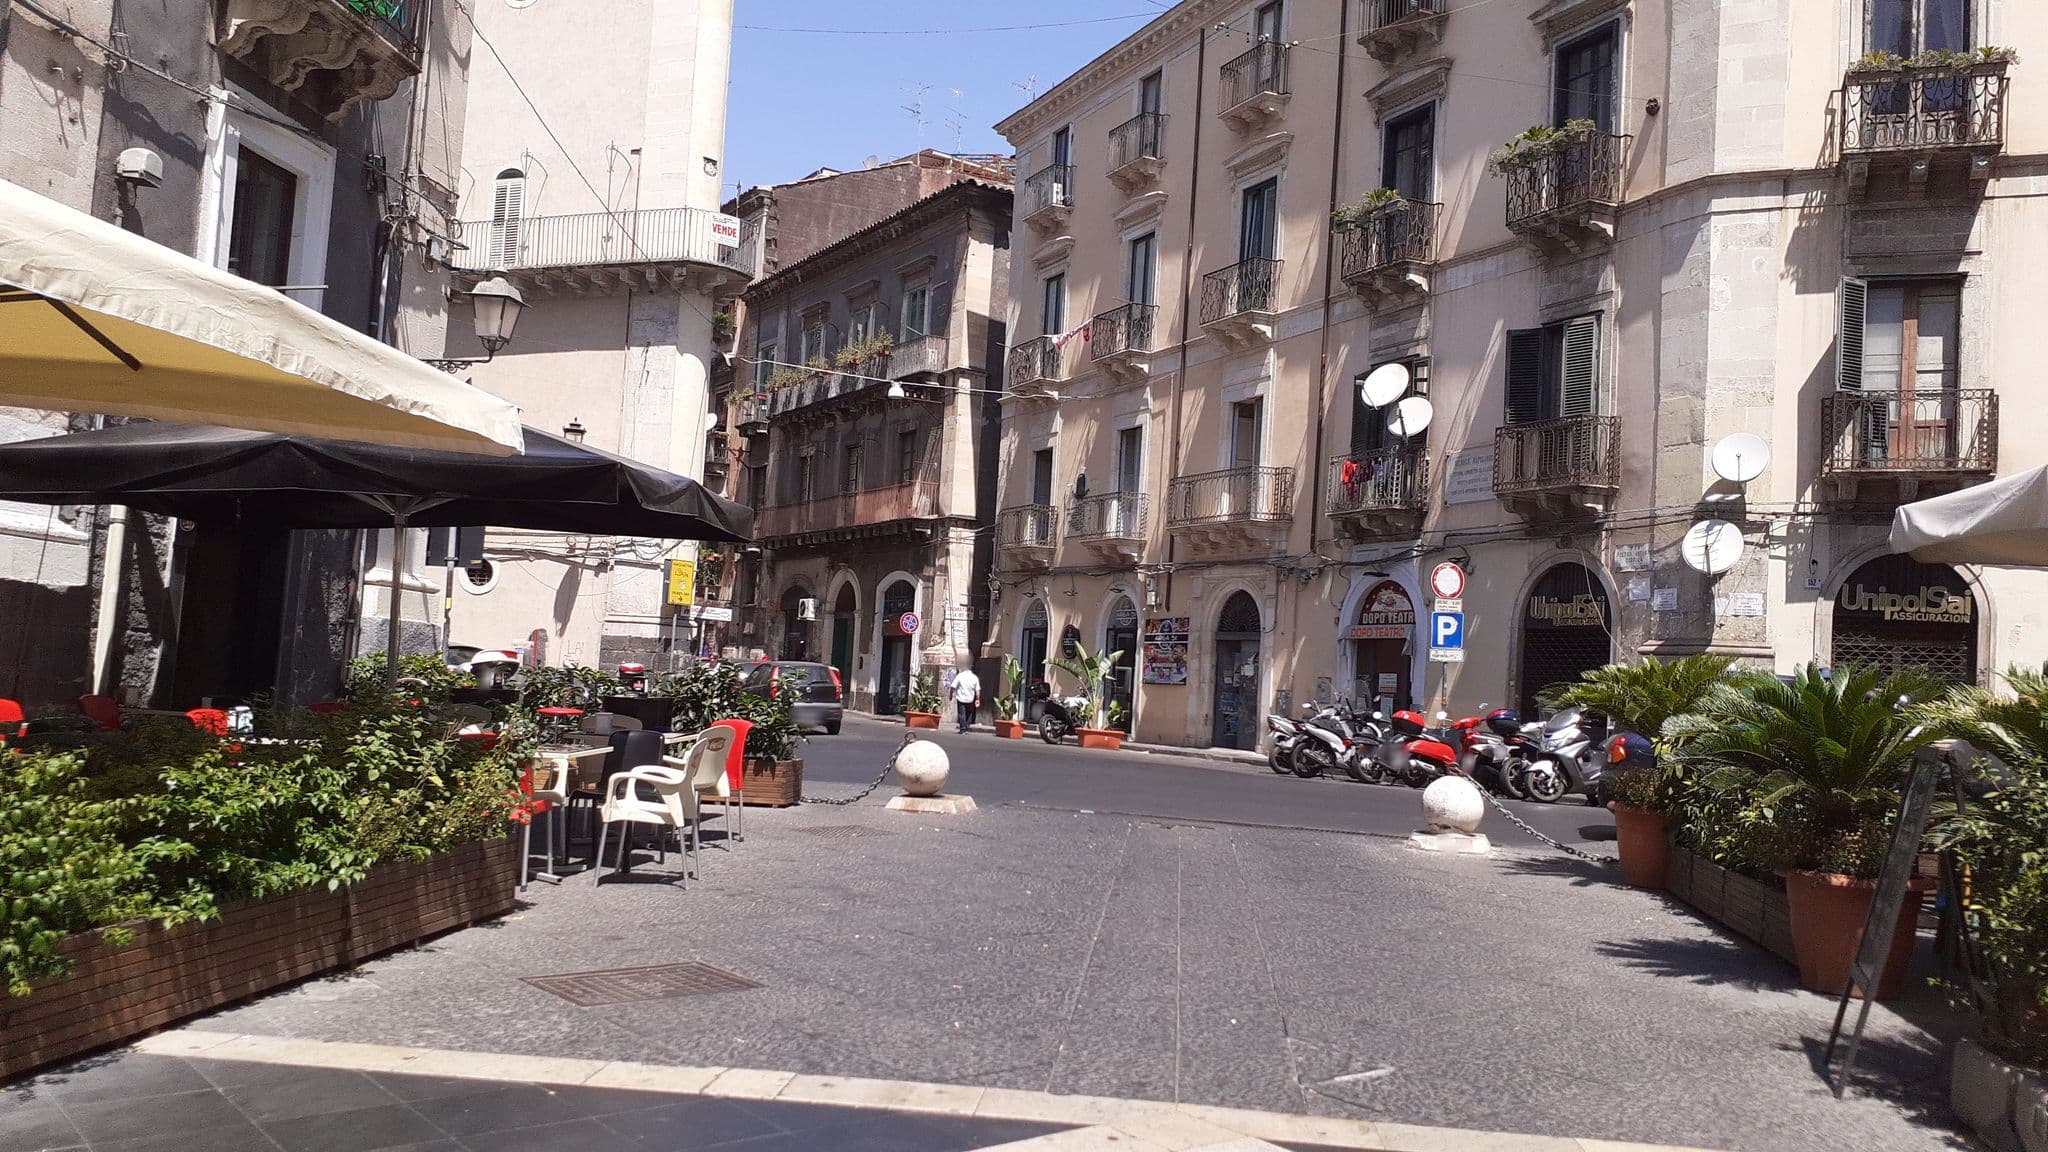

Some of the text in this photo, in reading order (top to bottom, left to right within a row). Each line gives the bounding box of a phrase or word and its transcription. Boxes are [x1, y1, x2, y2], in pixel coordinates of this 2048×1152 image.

[712, 223, 737, 238] VENDE
[1841, 584, 1972, 620] UnipolSai
[1363, 613, 1386, 625] DOPO
[1351, 628, 1405, 637] DOPO TEATRO
[1437, 615, 1458, 646] P
